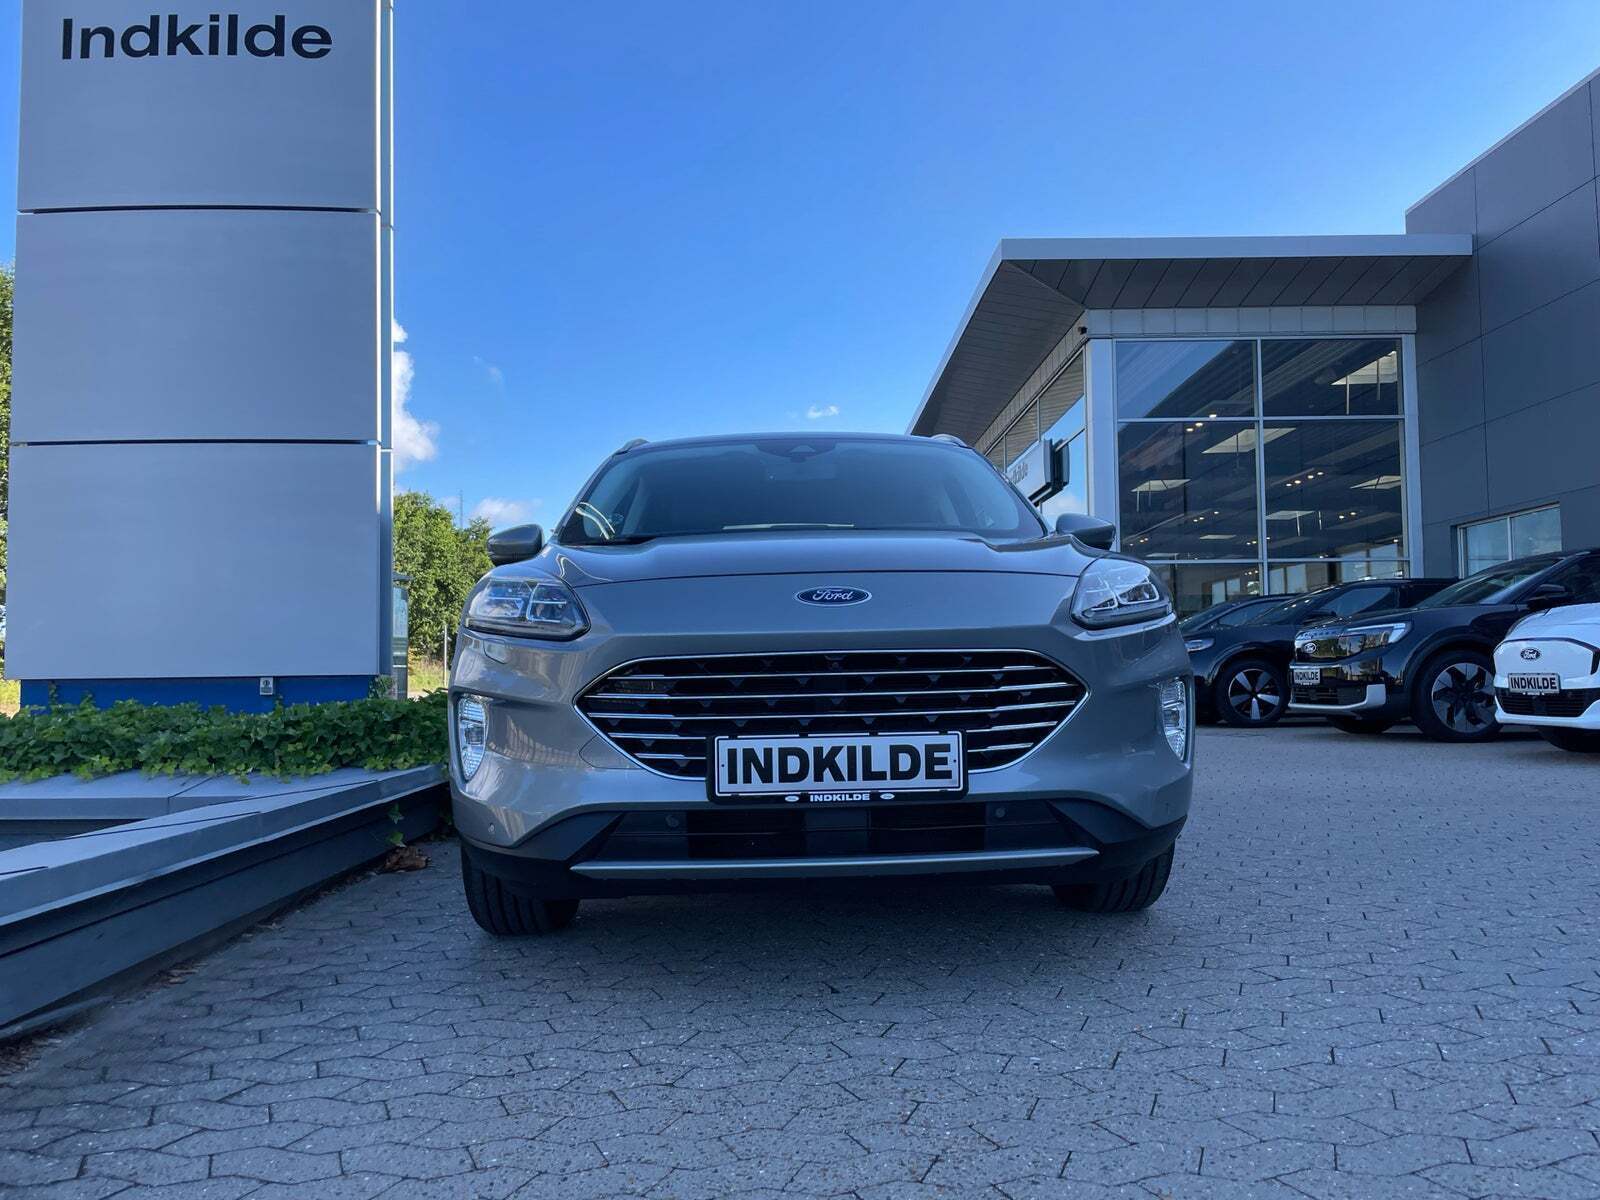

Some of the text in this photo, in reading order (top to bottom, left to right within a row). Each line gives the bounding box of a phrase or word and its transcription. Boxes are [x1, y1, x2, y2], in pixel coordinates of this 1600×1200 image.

[61, 14, 333, 60] Indkilde
[812, 588, 854, 601] Ford
[1510, 676, 1557, 690] INDKILDE
[727, 743, 953, 785] INDKILDE
[809, 793, 871, 802] INDKILDE
